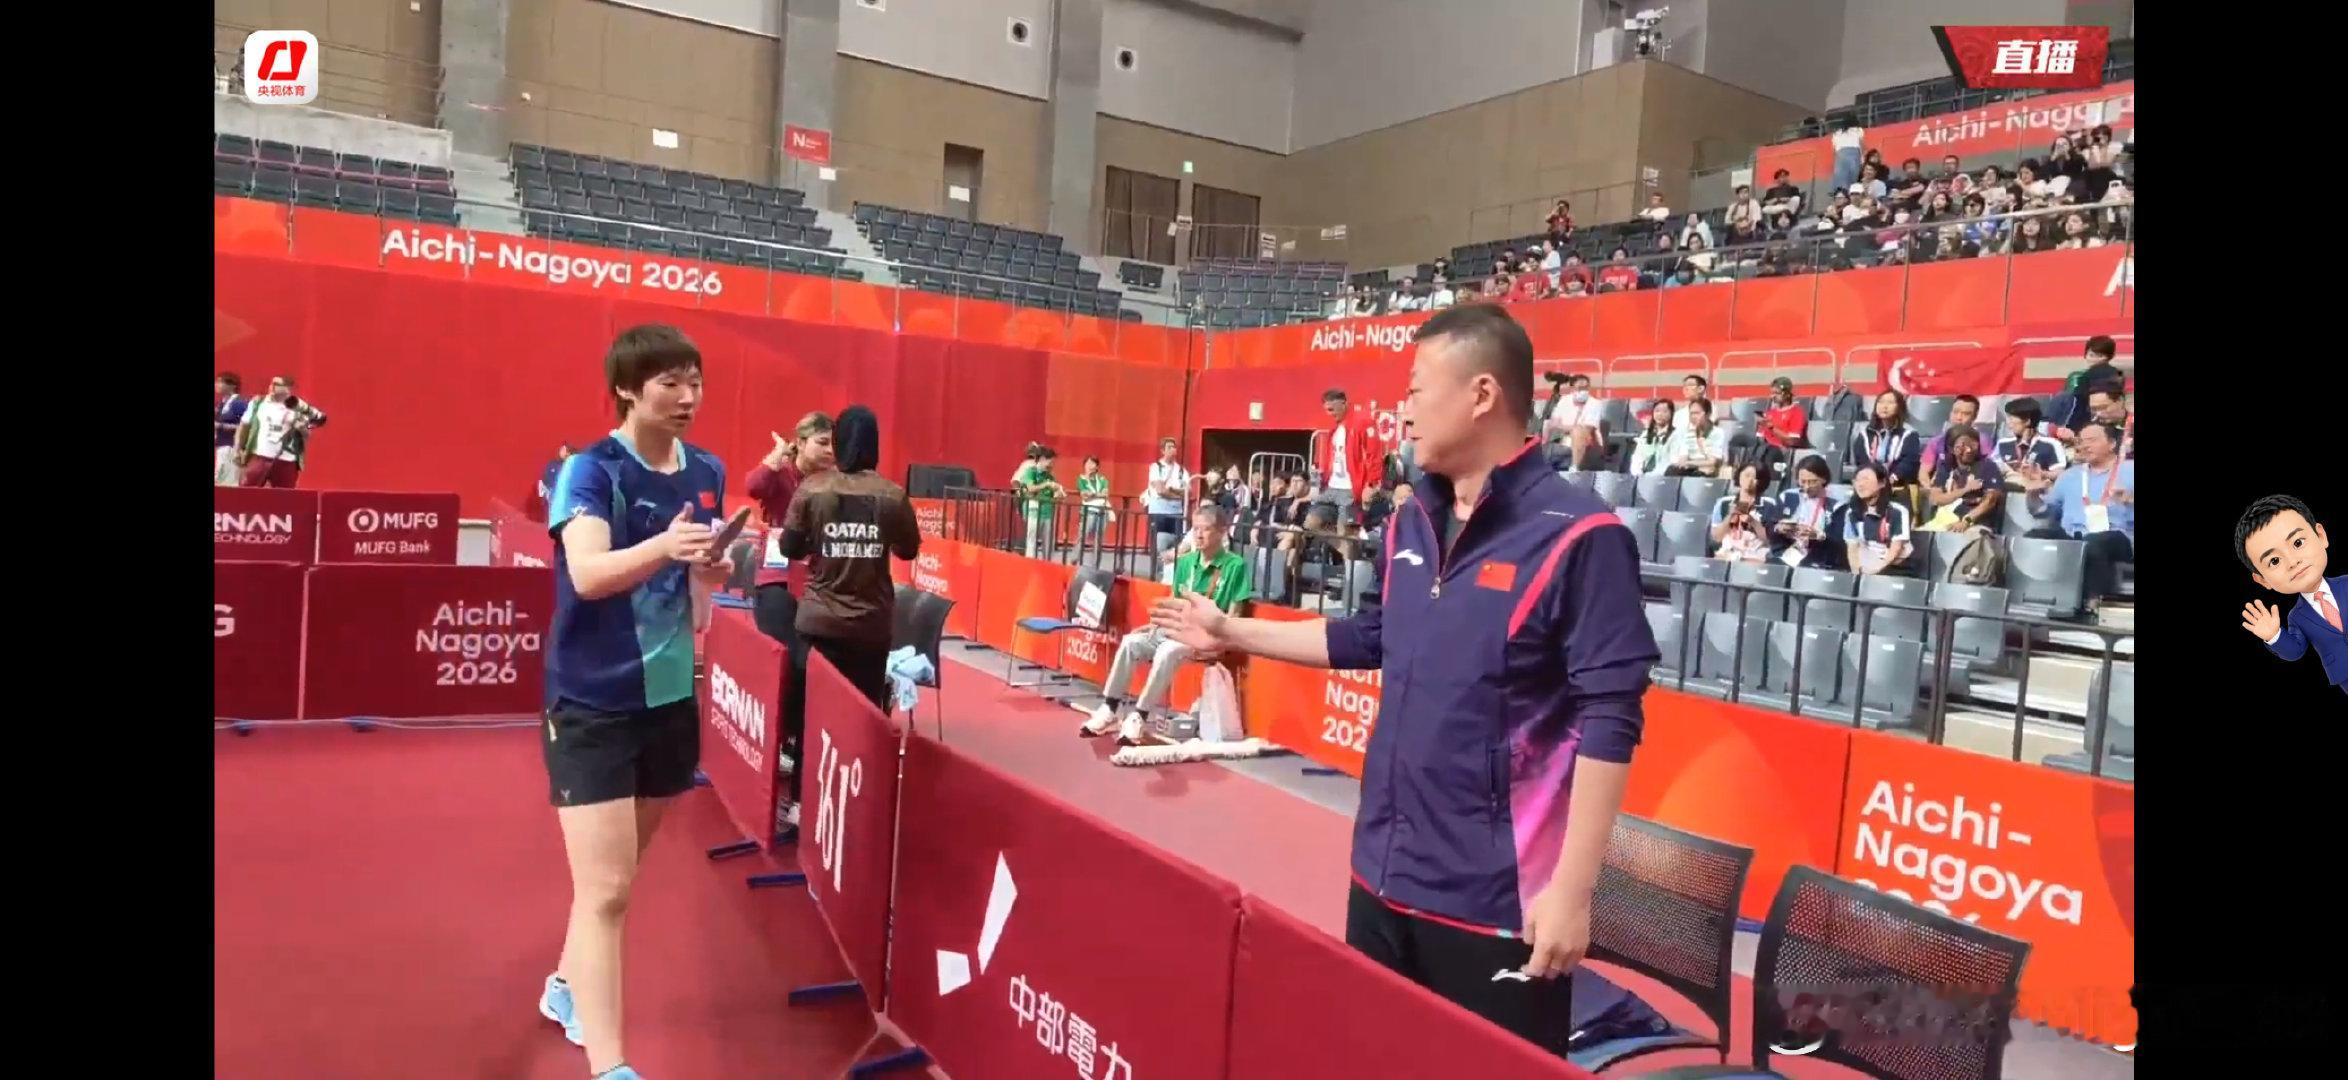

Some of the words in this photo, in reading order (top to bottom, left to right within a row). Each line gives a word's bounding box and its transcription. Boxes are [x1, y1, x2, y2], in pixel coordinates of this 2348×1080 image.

[382, 227, 632, 288] Aichi-Nagoya
[641, 262, 723, 296] 2026
[383, 512, 438, 530] MUFG
[824, 522, 879, 540] QATAR
[354, 541, 395, 555] MUFG
[400, 539, 431, 554] Bank
[432, 600, 530, 627] Aichi-
[415, 627, 541, 658] Nagoya
[436, 660, 518, 686] 2026
[1861, 780, 2033, 850] Aichi-
[1853, 822, 2084, 926] Nagoya
[1009, 974, 1133, 1080] 中部電力
